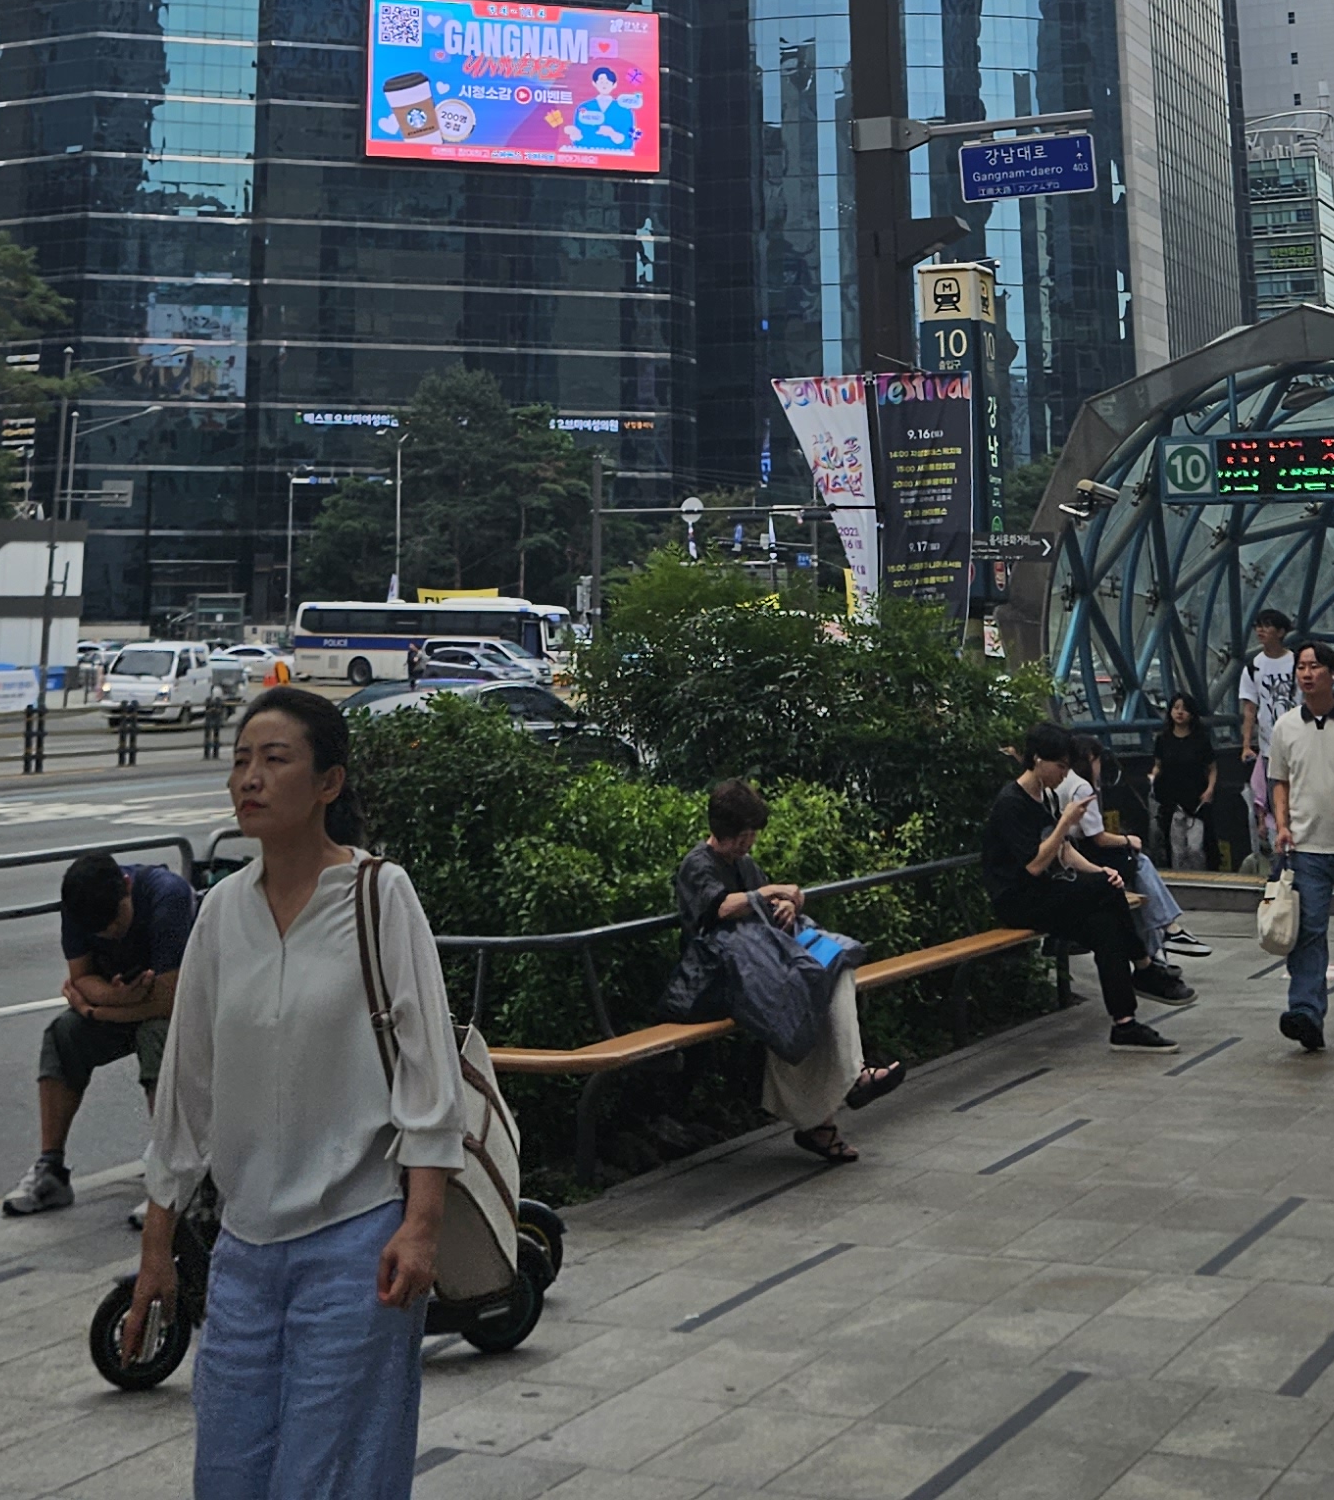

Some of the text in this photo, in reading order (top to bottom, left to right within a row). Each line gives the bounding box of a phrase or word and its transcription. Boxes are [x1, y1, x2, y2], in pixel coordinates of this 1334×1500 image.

[444, 19, 589, 64] GANGNAM
[458, 83, 574, 105] 시청소감 이벤트
[985, 140, 1080, 166] 강남대로 1
[972, 163, 1089, 184] Gangnam-daero 403
[934, 328, 968, 358] 10
[1171, 453, 1207, 484] 10
[323, 637, 348, 647] POLICE
